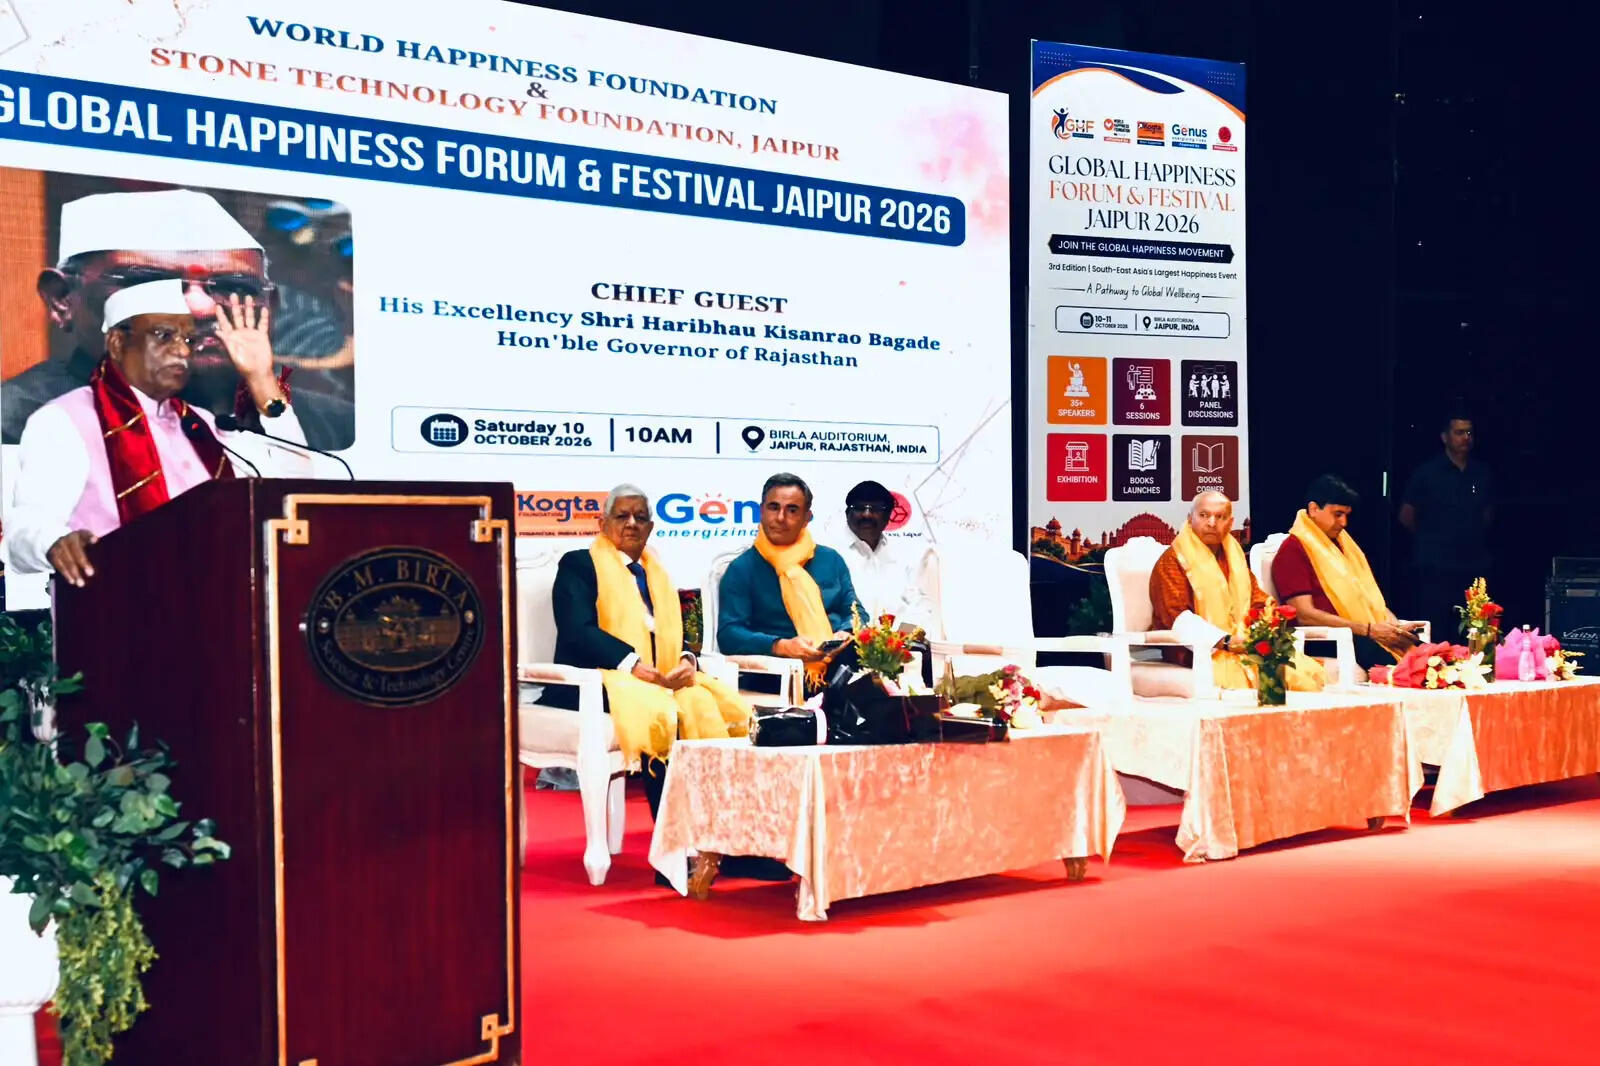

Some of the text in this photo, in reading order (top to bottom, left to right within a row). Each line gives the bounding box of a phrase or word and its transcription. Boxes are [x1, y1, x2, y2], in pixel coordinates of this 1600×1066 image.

[247, 15, 778, 115] WORLD HAPPINESS FOUNDATION
[526, 81, 549, 100] &
[151, 47, 840, 162] STONE TECHNOLOGY FOUNDATION, JAIPUR
[1065, 118, 1095, 133] GHF
[1172, 124, 1207, 138] Genus
[0, 83, 951, 234] GLOBAL HAPPINESS FORUM & FESTIVAL JAIPUR 2026
[1048, 154, 1236, 187] GLOBAL HAPPINESS
[1049, 180, 1235, 212] FORUM & FESTIVAL
[1084, 208, 1200, 234] JAIPUR 2026
[1058, 240, 1225, 258] JOIN THE GLOBAL HAPPINESS MOVEMENT
[1048, 262, 1061, 271] 3rd
[1062, 263, 1087, 272] Edition
[1092, 265, 1131, 274] South-East
[1133, 267, 1153, 276] Asia's
[1154, 268, 1180, 279] Largest
[1181, 270, 1218, 280] Happiness
[1218, 271, 1238, 280] Event
[591, 282, 788, 314] CHIEF GUEST
[1086, 282, 1200, 304] A Pathway to Global Wellbeing
[379, 296, 941, 352] His Excellency Shri Haribhau Kisanrao Bagade
[1095, 315, 1112, 323] 10-11
[1154, 323, 1180, 331] JAIPUR,
[497, 330, 858, 367] Hon'ble Governor of Rajasthan
[1058, 408, 1096, 417] SPEAKERS
[1199, 401, 1222, 409] PANEL
[1126, 411, 1160, 420] SESSIONS
[1188, 410, 1234, 419] DISCUSSIONS
[474, 419, 585, 436] Saturday 10
[625, 426, 692, 444] 10AM
[474, 434, 592, 447] OCTOBER 2026
[770, 430, 890, 443] BIRLA AUDITORIUM,
[770, 441, 927, 454] JAIPUR, RAJASTHAN, INDIA
[1057, 475, 1098, 484] EXHIBITION
[1130, 476, 1154, 485] BOOKS
[1198, 476, 1222, 484] BOOKS
[1123, 486, 1161, 494] LAUNCHES
[516, 494, 600, 522] Kogta
[656, 493, 762, 524] Gen
